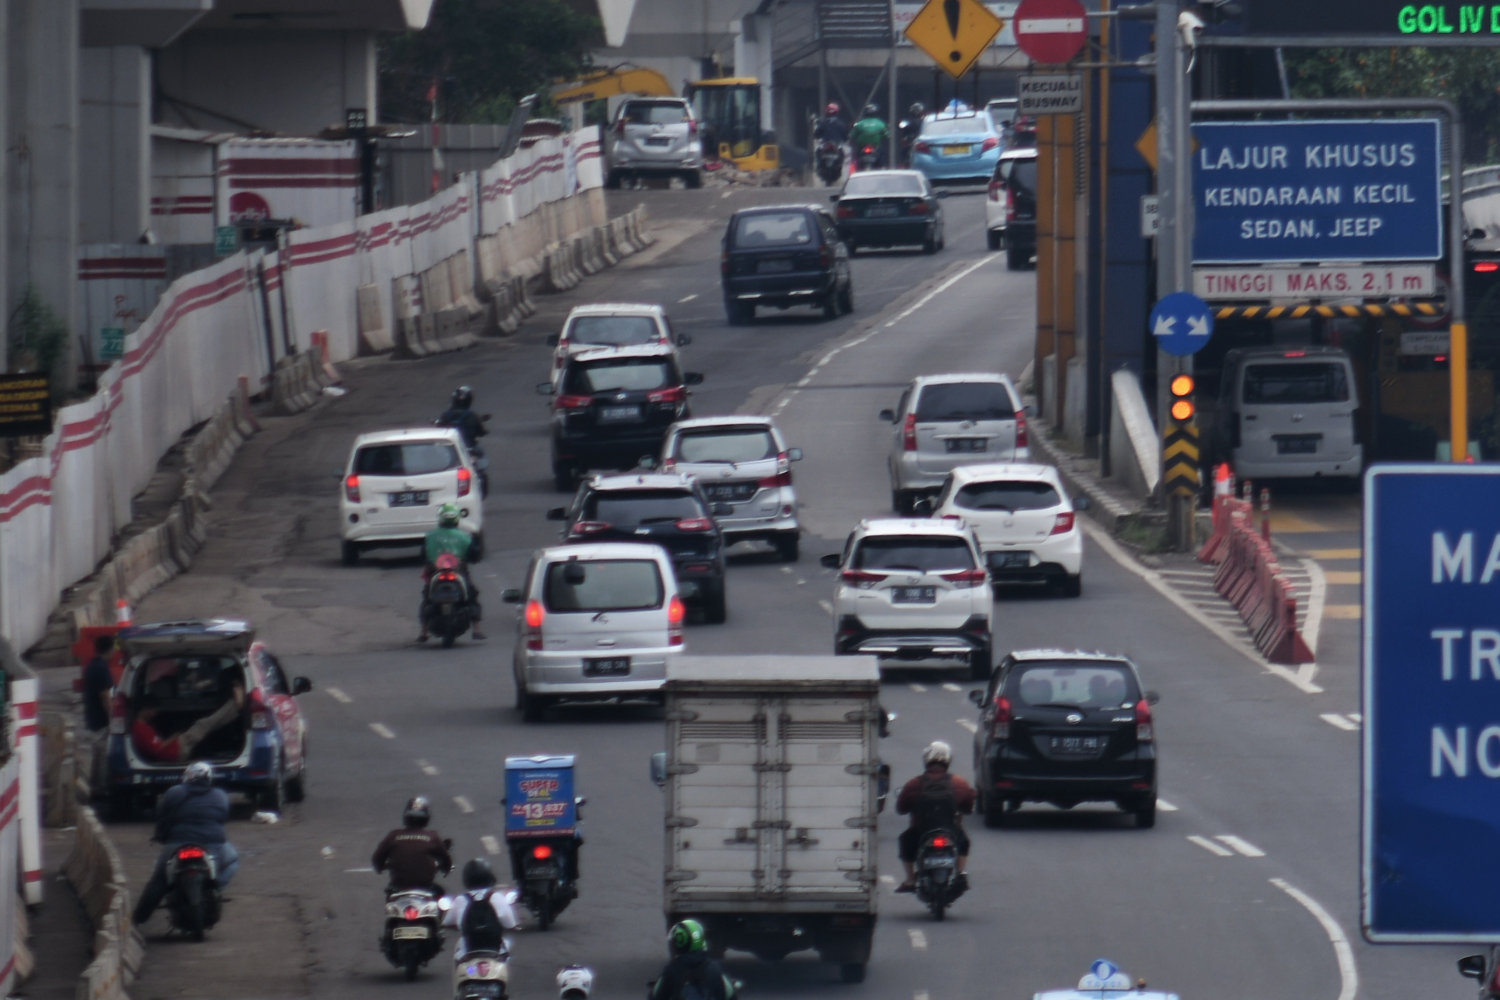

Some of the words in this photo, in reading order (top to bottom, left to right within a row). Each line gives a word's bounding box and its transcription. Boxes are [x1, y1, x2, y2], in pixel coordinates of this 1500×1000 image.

[1398, 5, 1454, 34] GOL
[1459, 5, 1484, 34] IV
[1022, 81, 1079, 93] KECUALI
[1022, 96, 1078, 108] BUSWAY
[1200, 146, 1288, 170] LAJUR
[1305, 143, 1416, 168] KHUSUS
[1205, 187, 1340, 207] KENDARAAN
[1353, 184, 1415, 204] KECIL
[1328, 218, 1383, 238] JEEP
[1204, 274, 1273, 294] TINGGI
[1287, 273, 1352, 292] MAKS.
[1403, 275, 1422, 289] m
